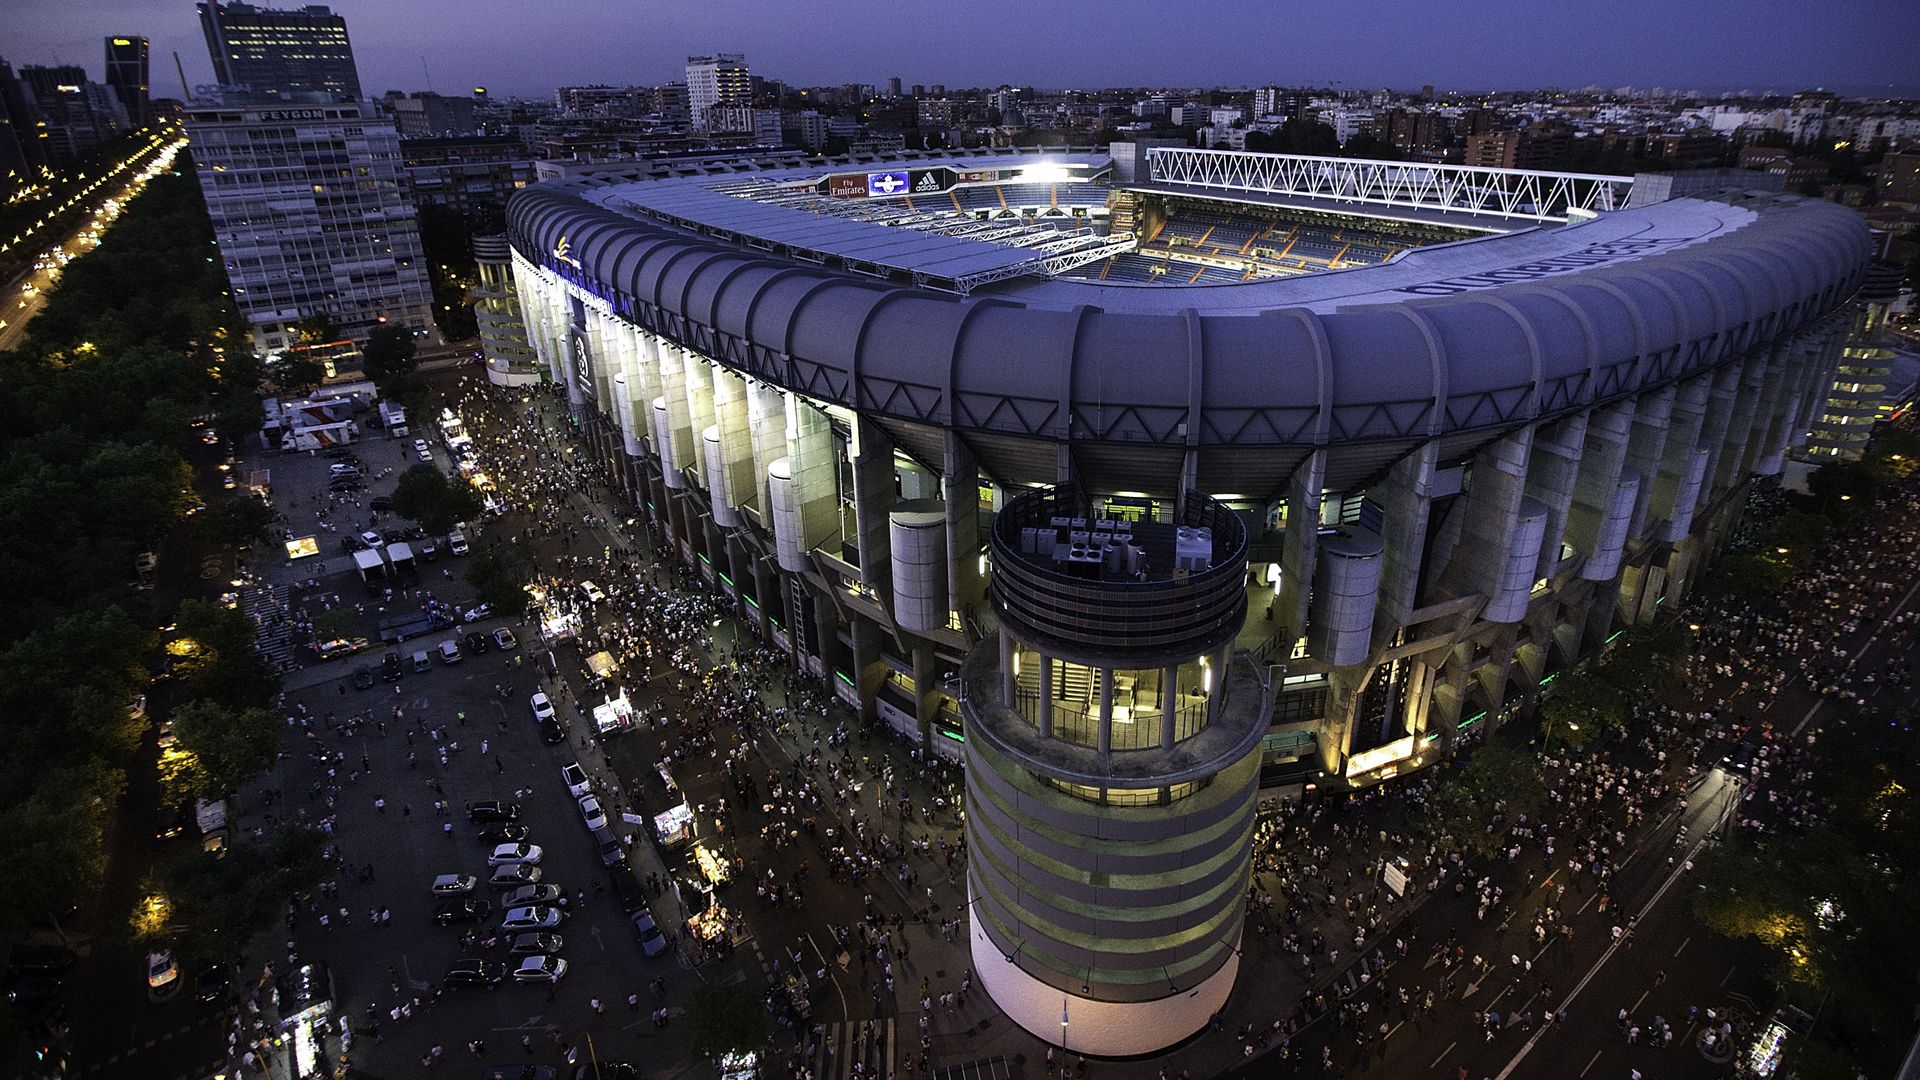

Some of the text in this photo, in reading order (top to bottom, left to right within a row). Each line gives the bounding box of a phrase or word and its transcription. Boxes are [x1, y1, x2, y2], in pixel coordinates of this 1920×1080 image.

[260, 110, 324, 120] FEYGON
[843, 179, 853, 187] Fly
[915, 183, 940, 192] adidas
[832, 186, 866, 196] Emirates
